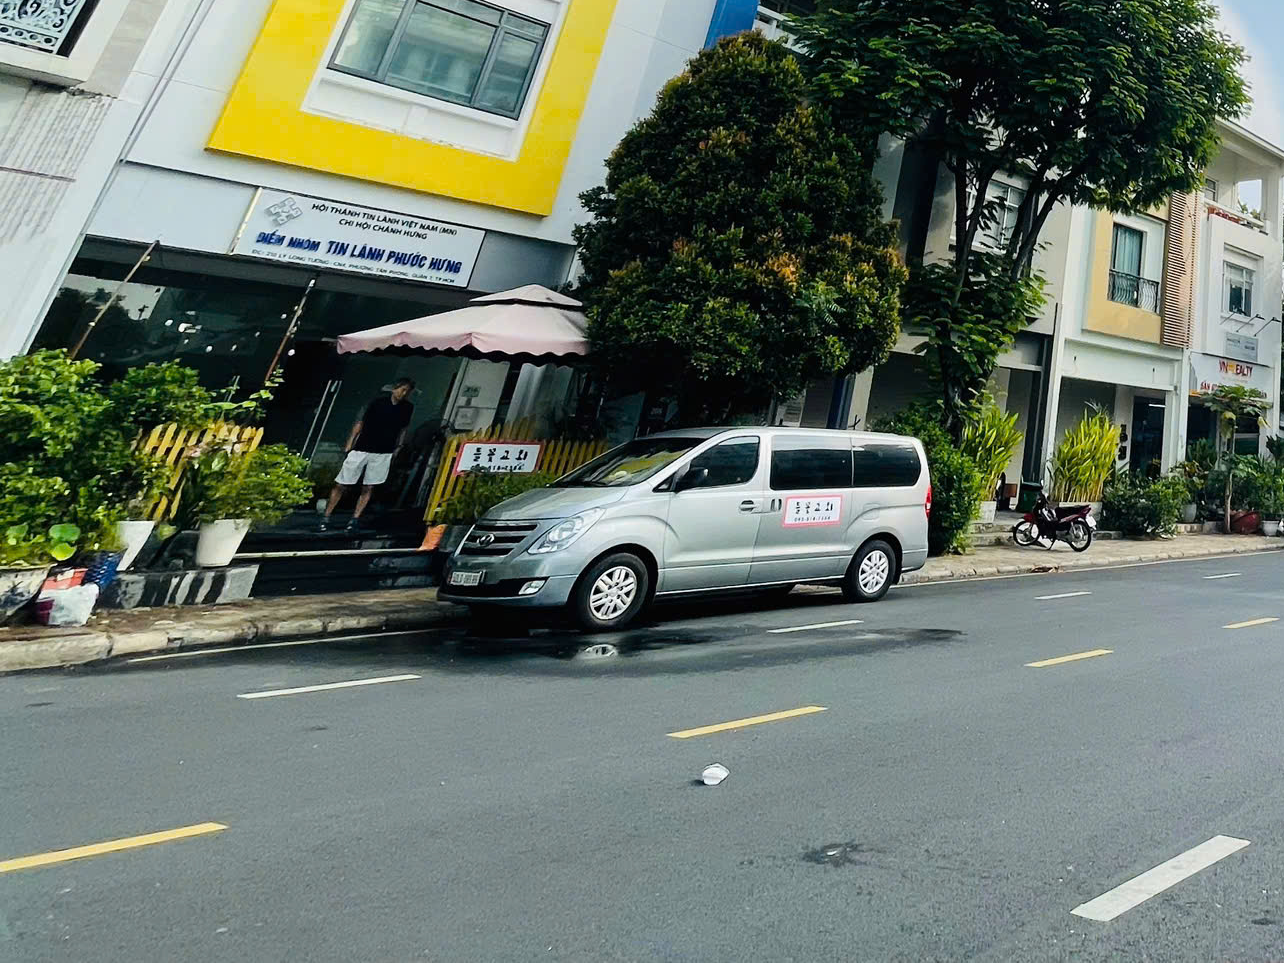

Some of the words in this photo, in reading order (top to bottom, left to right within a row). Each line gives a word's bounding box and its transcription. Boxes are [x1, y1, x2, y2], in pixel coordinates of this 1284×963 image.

[339, 218, 354, 227] CHI
[362, 212, 376, 221] TIN
[420, 223, 438, 232] NAM
[439, 227, 458, 236] (MN)
[326, 240, 350, 256] TIN
